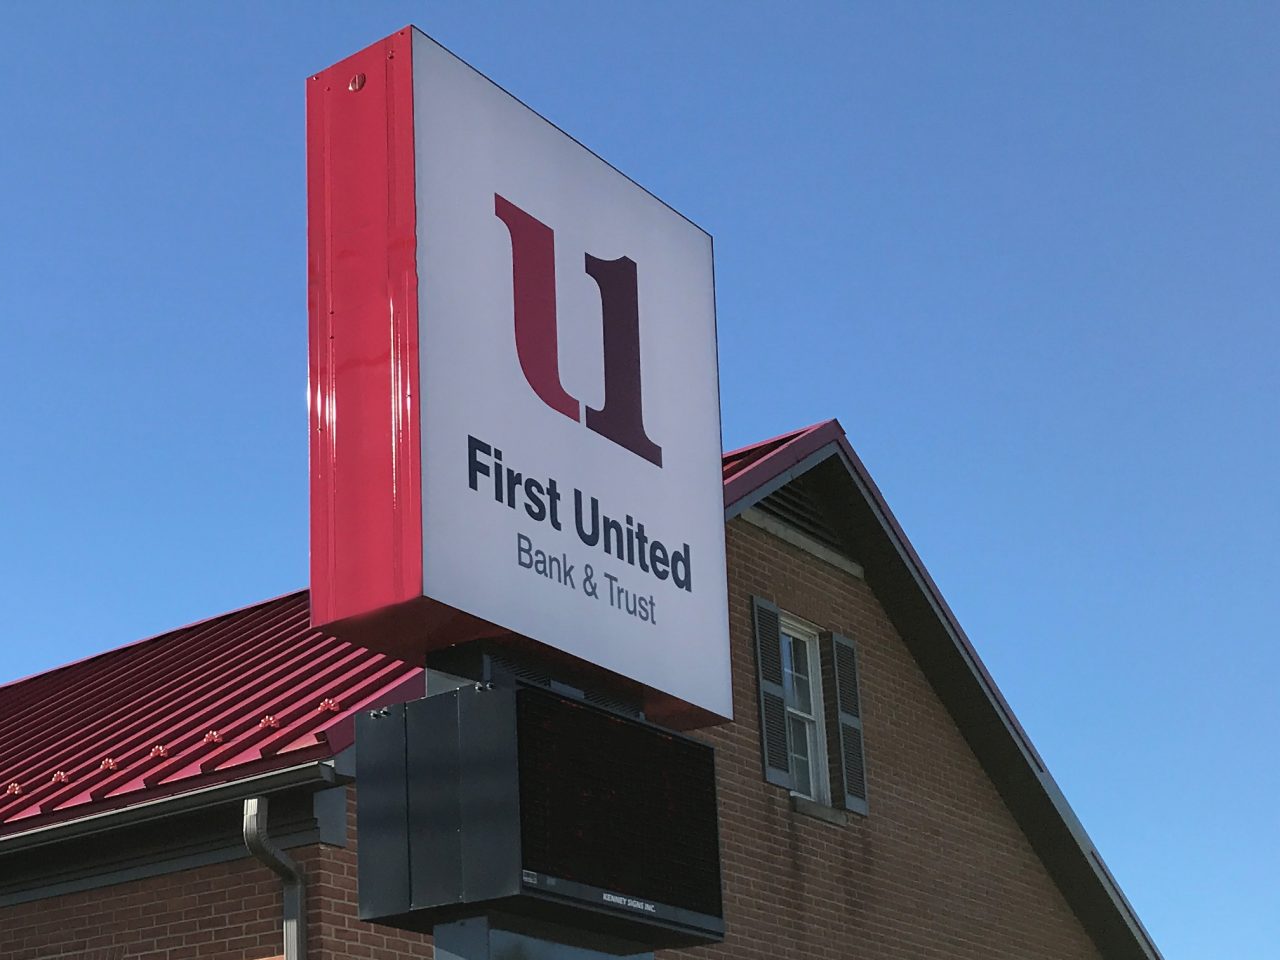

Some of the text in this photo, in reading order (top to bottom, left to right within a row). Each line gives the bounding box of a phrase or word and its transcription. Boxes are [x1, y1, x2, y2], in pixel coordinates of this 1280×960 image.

[467, 433, 693, 593] First United
[516, 532, 657, 626] Bank & Trust
